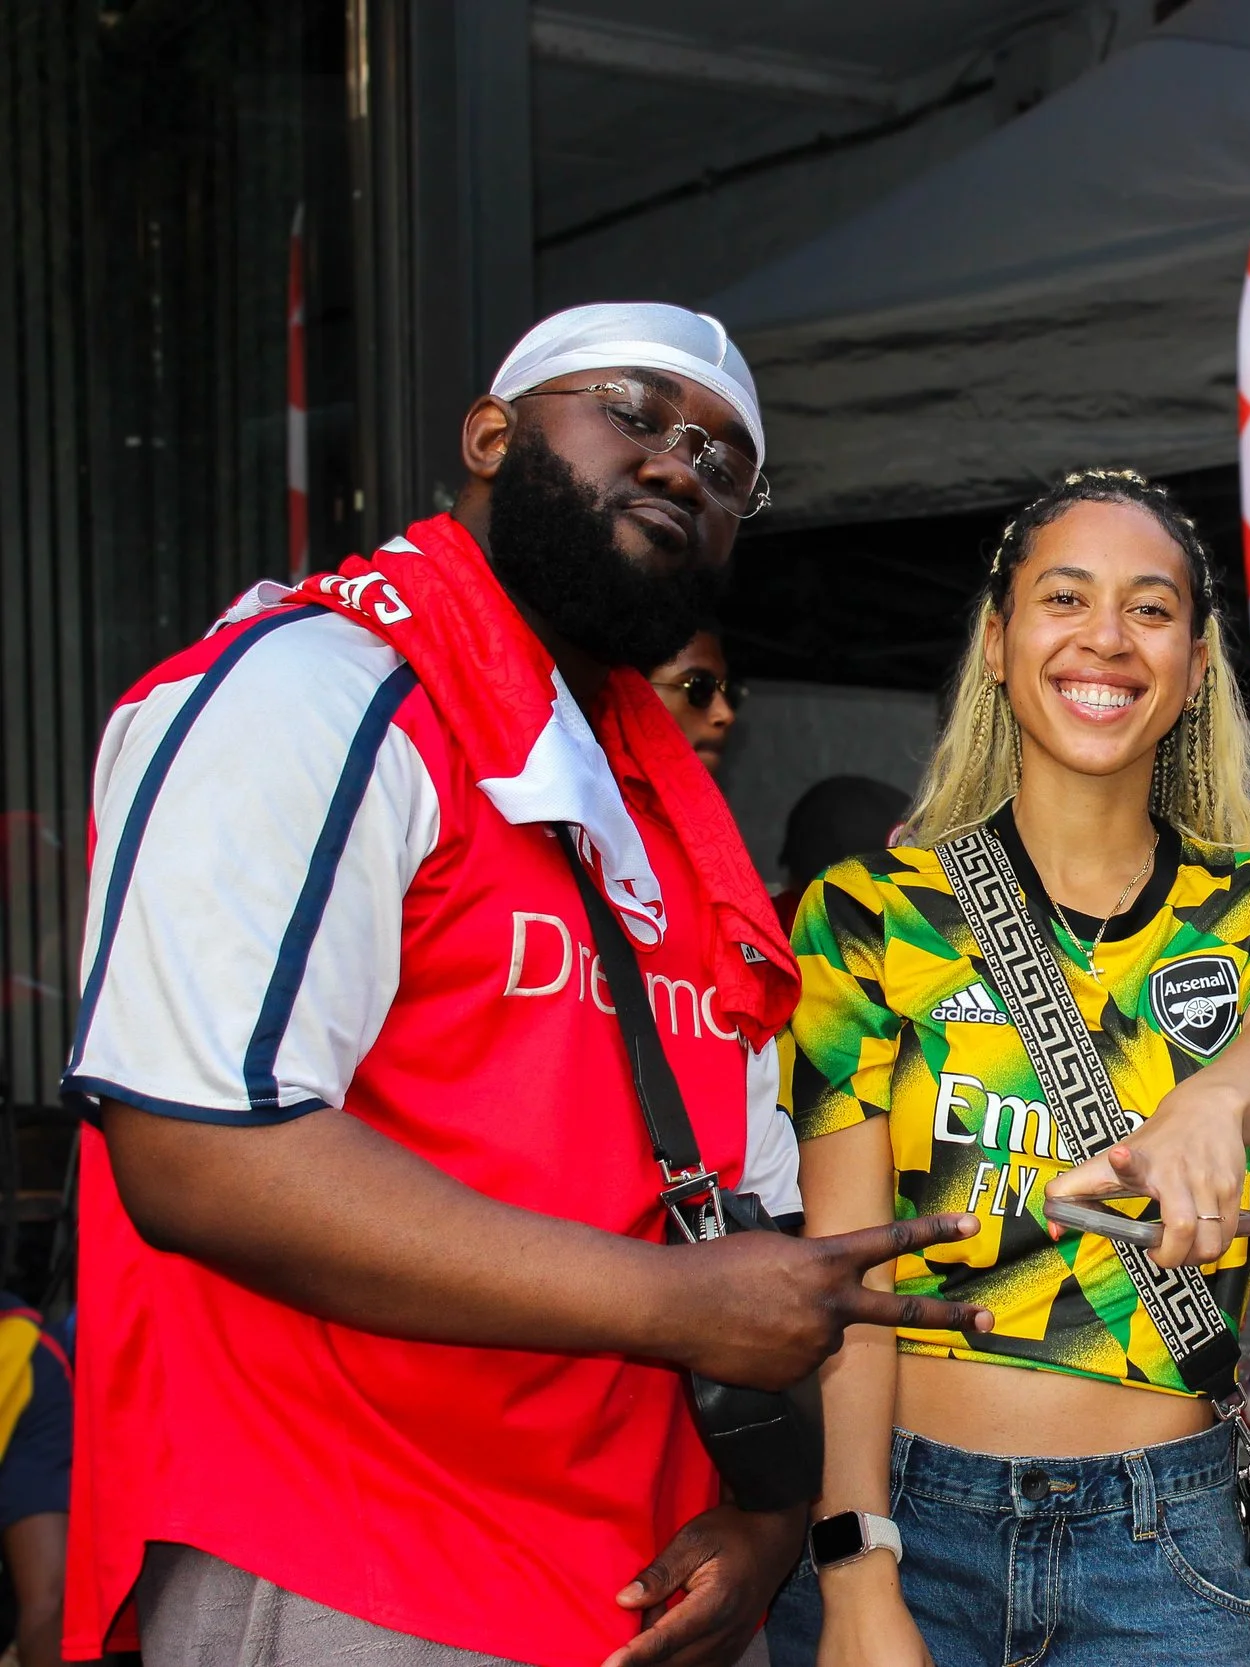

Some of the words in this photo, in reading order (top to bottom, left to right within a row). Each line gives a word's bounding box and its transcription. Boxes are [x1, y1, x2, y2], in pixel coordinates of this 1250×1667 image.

[1164, 971, 1226, 997] Arsenal
[931, 1006, 1009, 1025] adidas
[967, 1162, 1038, 1218] FLY
